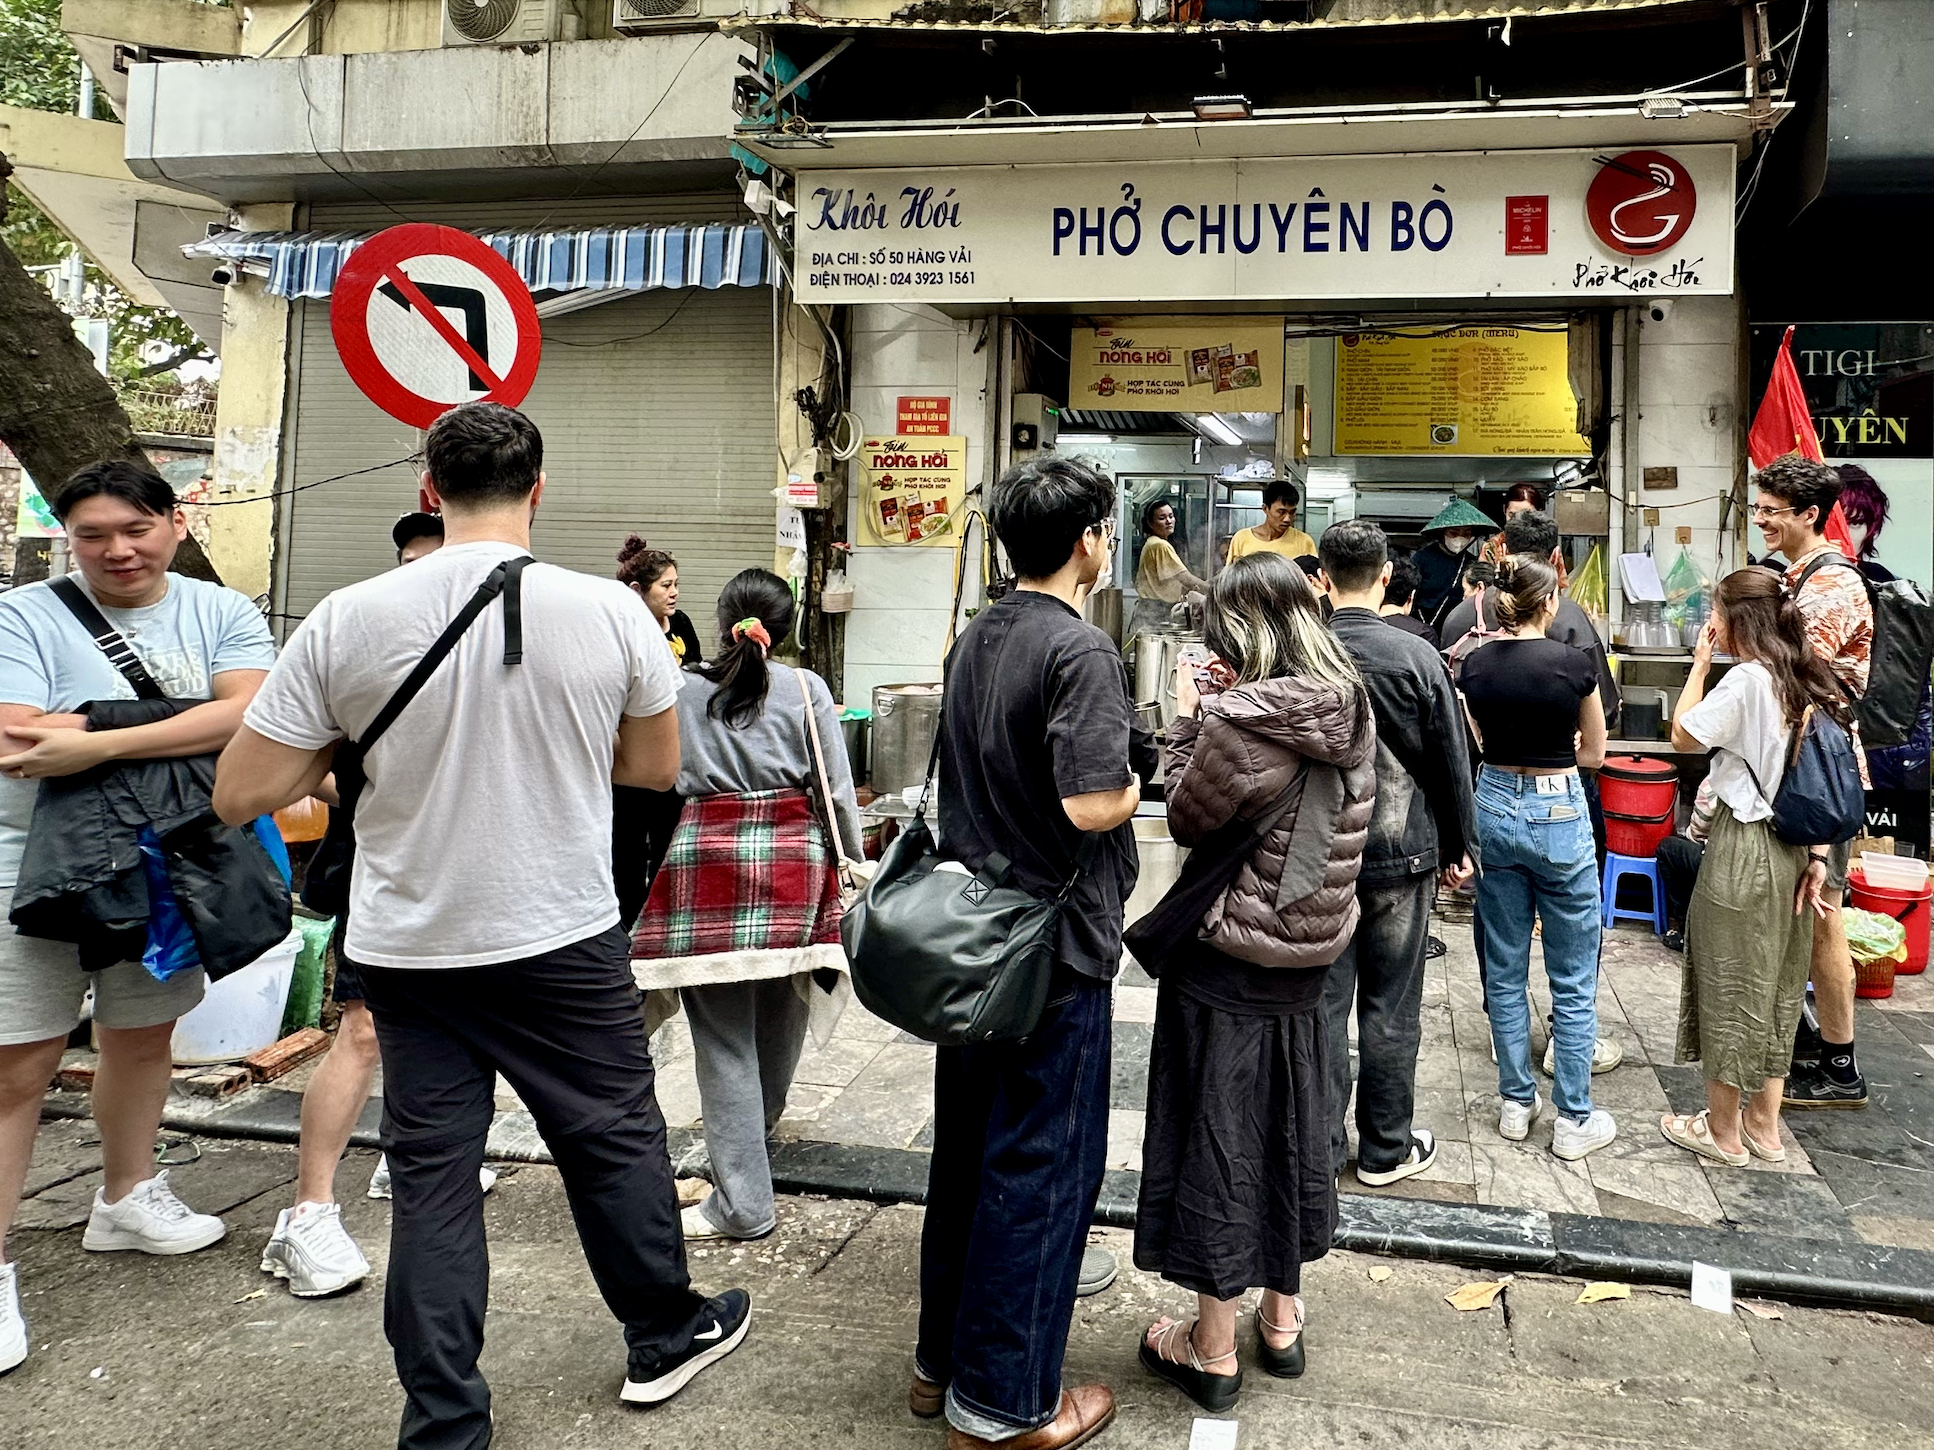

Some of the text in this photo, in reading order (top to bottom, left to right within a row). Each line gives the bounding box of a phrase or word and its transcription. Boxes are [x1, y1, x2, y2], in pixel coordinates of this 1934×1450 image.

[807, 187, 962, 230] Khôi Hói
[1052, 182, 1454, 257] PHỞ CHUYÊN BÒ
[812, 253, 834, 267] ĐỊA
[869, 247, 886, 265] SỐ
[889, 251, 904, 264] 50
[907, 247, 946, 264] HÀNG
[949, 245, 972, 264] VẢI
[810, 271, 840, 289] ĐIỆN
[843, 272, 880, 288] THOẠI
[890, 272, 912, 285] 024
[915, 272, 944, 285] 3923
[949, 271, 975, 285] 1561
[1800, 349, 1876, 377] TIGI
[1866, 807, 1897, 827] VẢI
